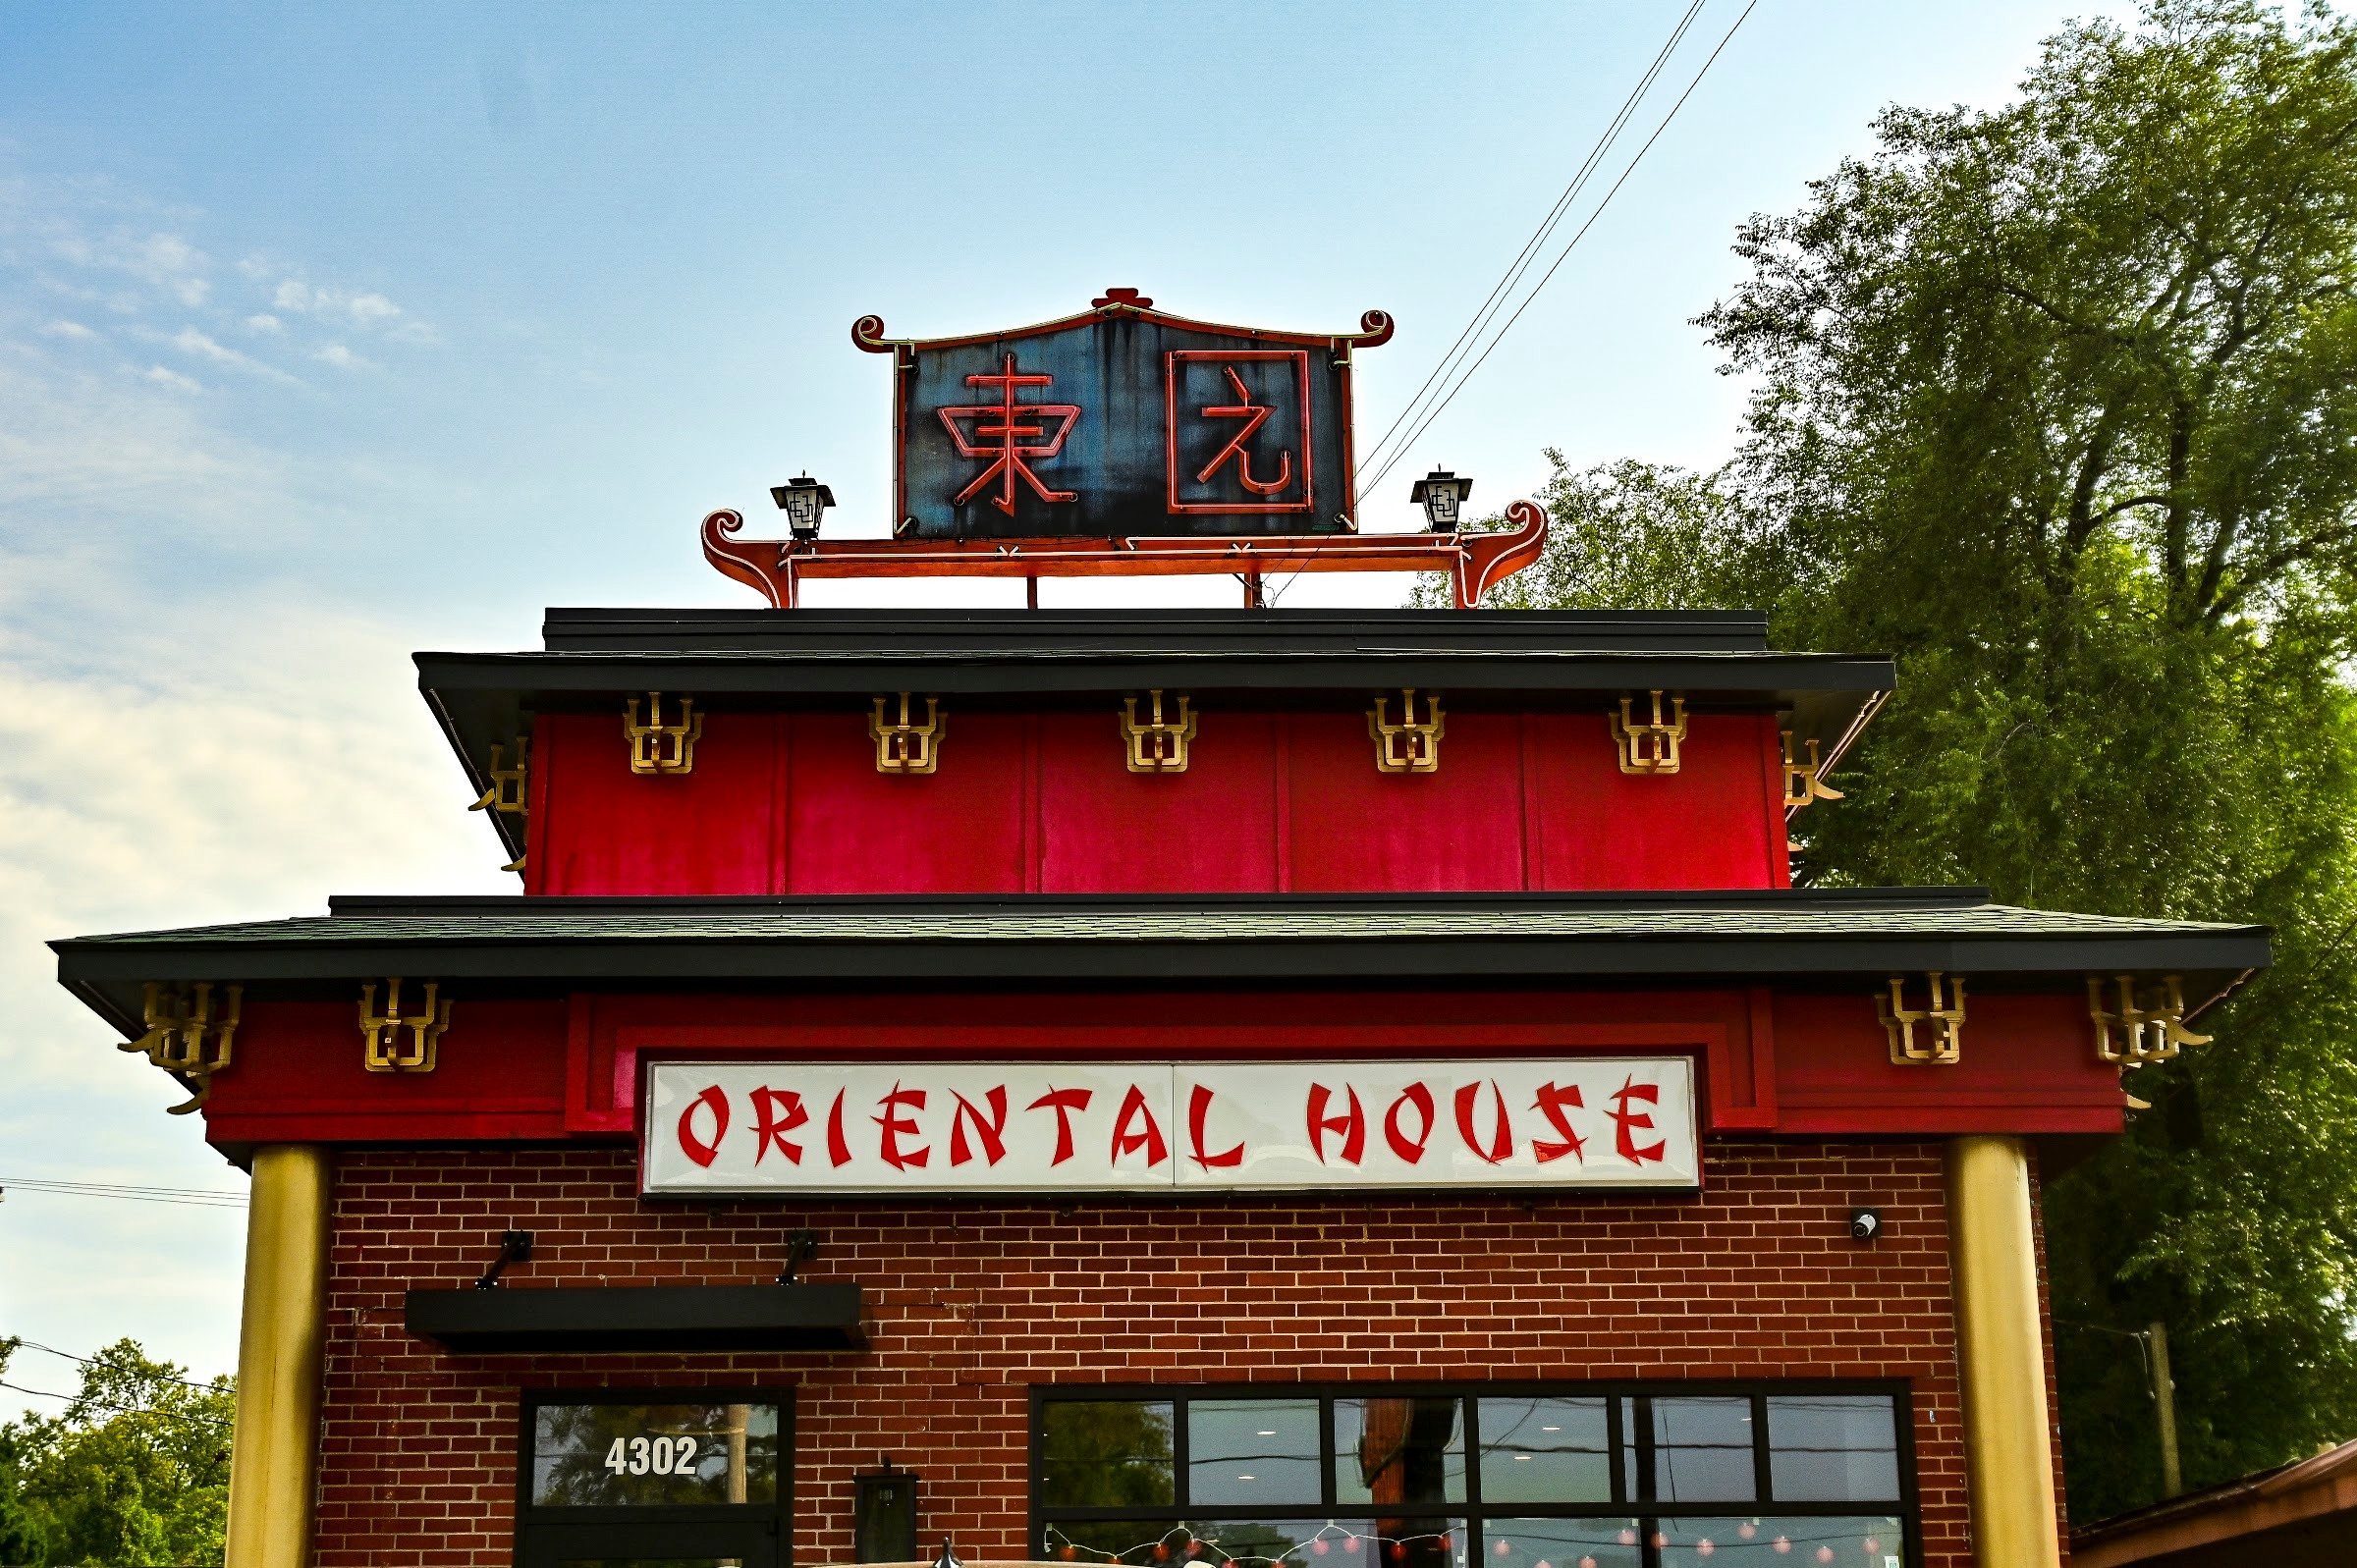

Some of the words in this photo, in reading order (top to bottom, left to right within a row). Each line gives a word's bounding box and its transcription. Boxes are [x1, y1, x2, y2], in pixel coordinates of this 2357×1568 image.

[677, 1079, 1245, 1172] ORIENTAL
[1306, 1074, 1667, 1166] HOUSE
[604, 1436, 698, 1476] 4302
